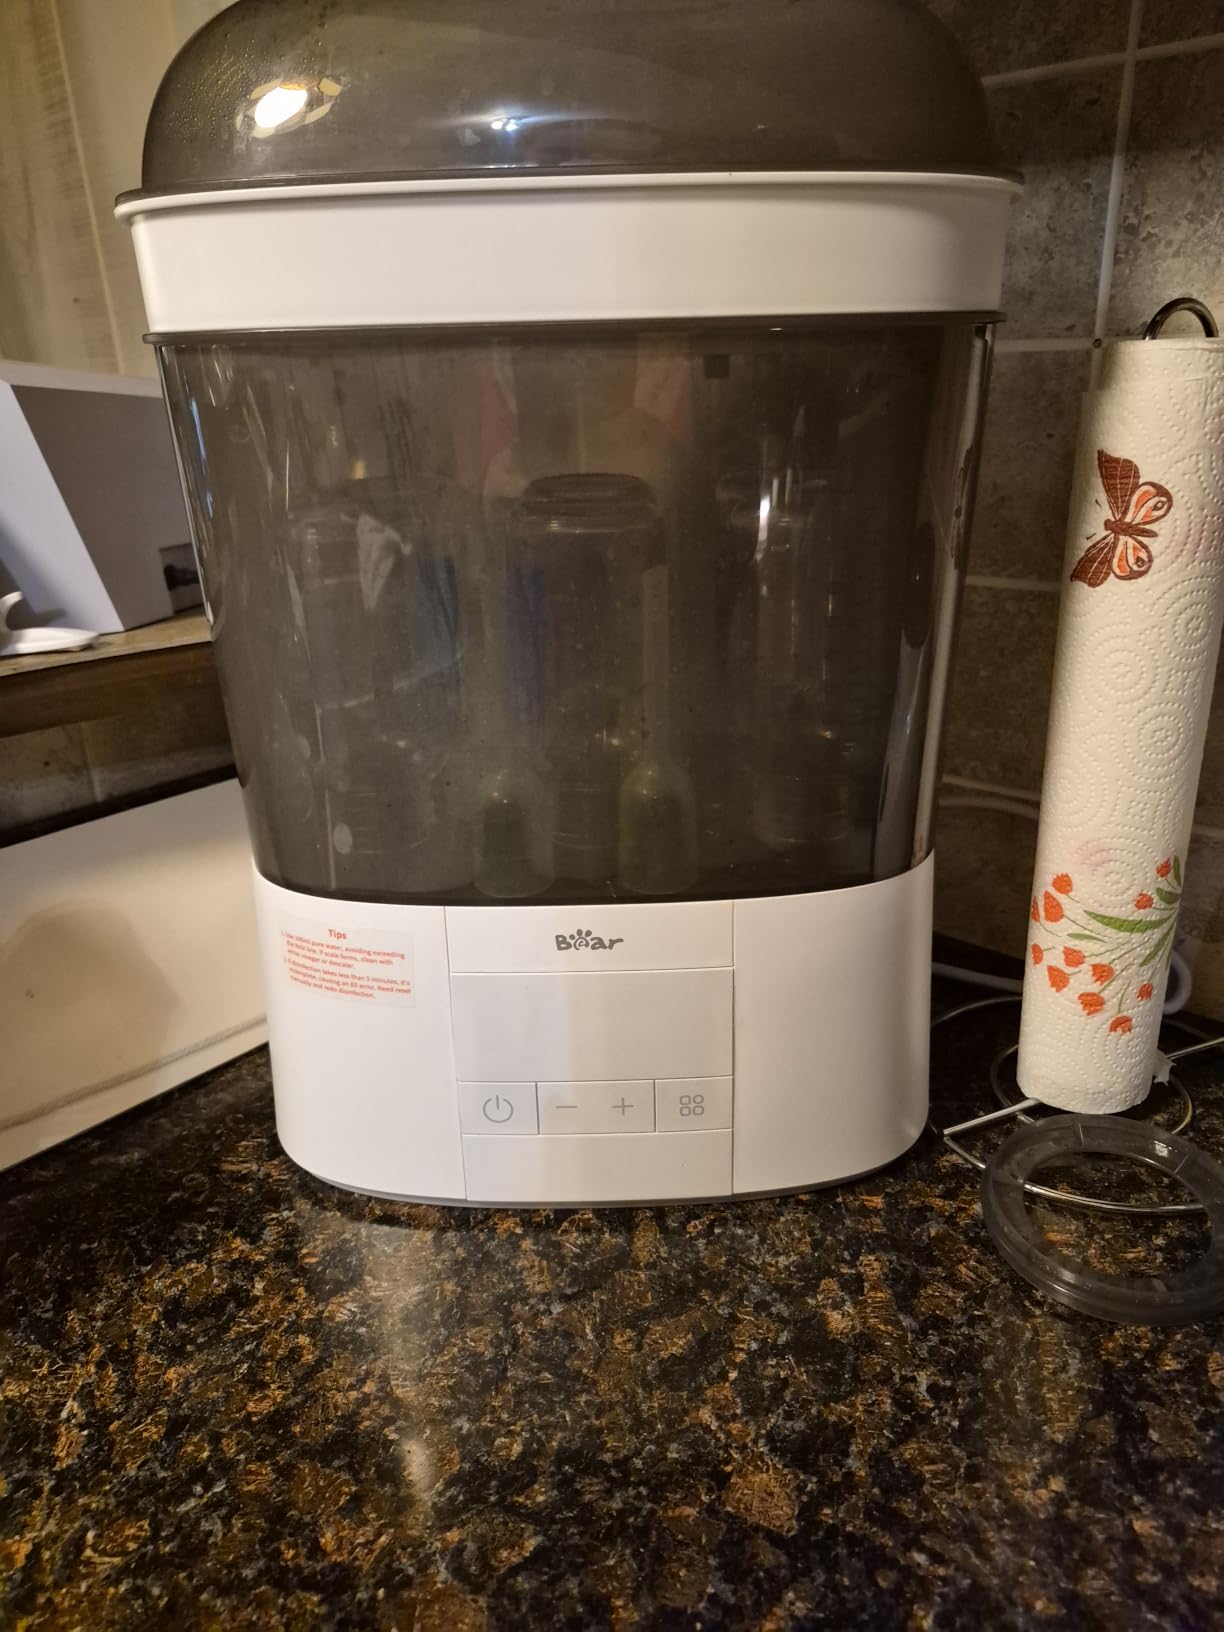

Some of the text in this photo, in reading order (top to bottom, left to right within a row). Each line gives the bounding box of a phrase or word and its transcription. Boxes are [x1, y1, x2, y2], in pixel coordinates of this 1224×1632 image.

[328, 929, 347, 940] Tips
[555, 928, 624, 951] Bear
[345, 946, 371, 956] avoiding
[373, 951, 405, 959] exceeding
[361, 957, 377, 965] clean
